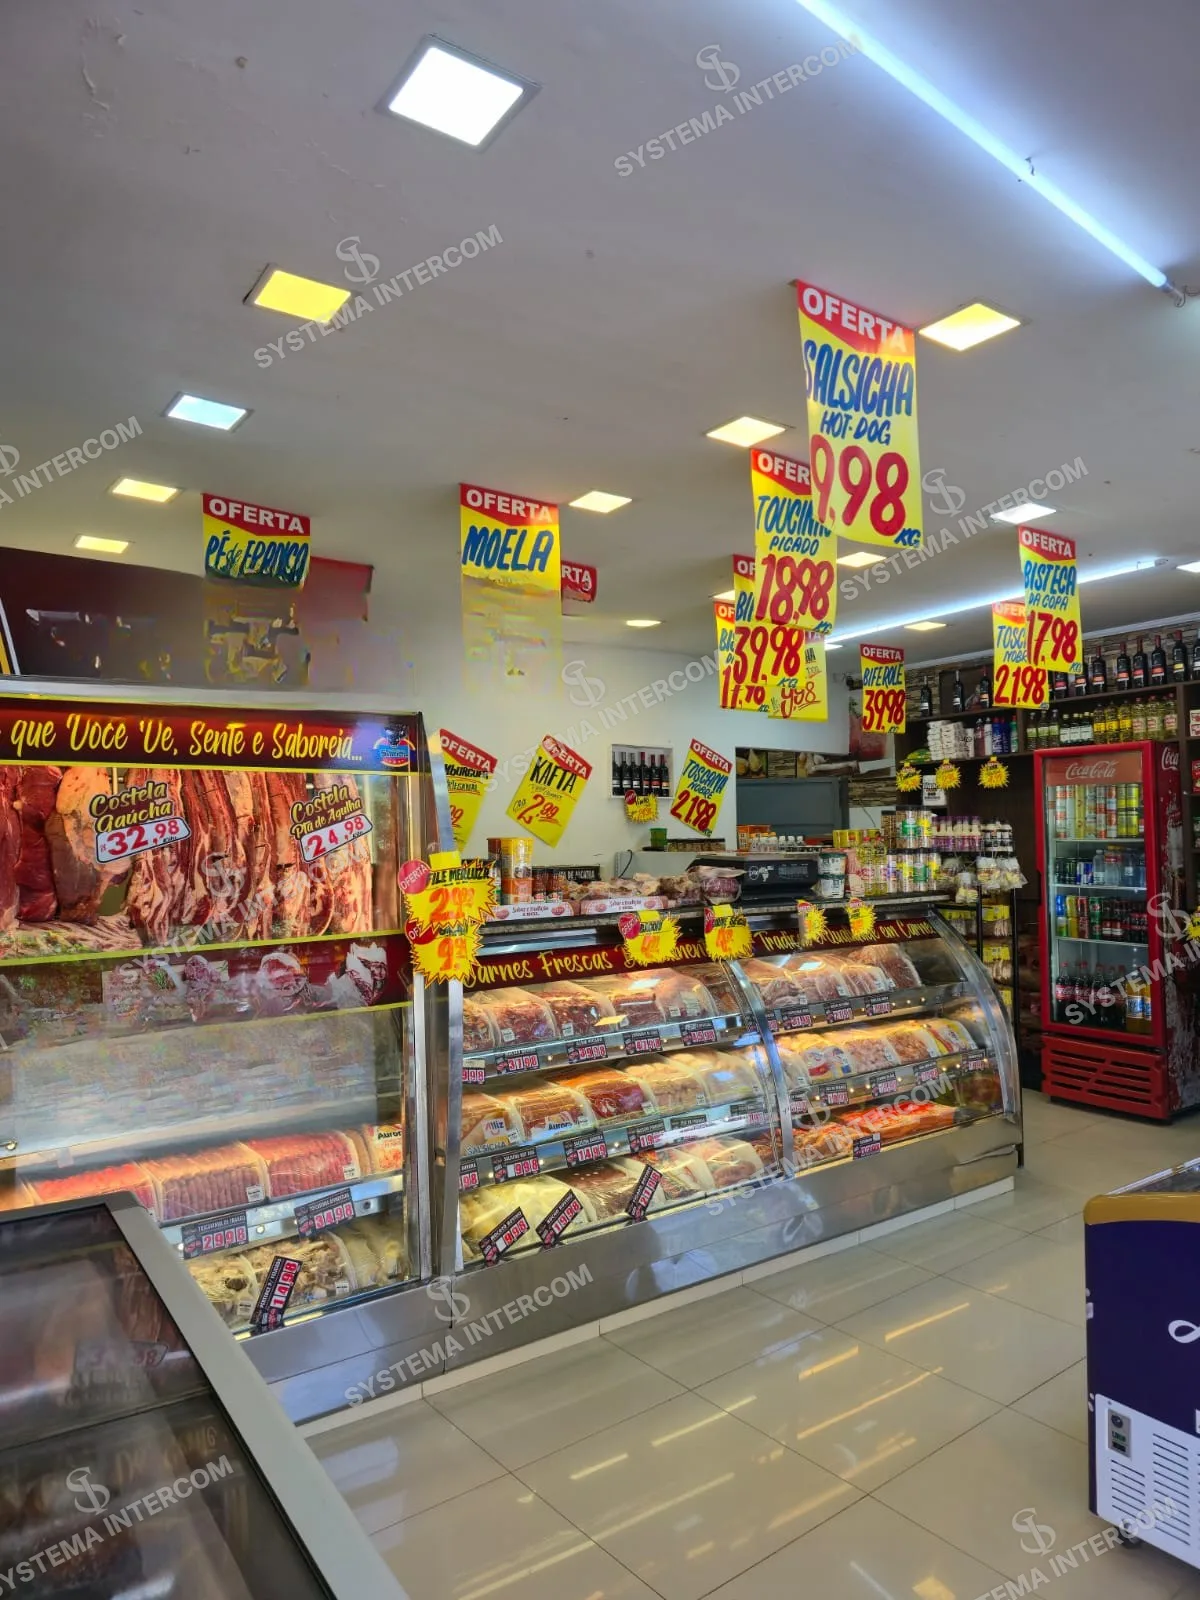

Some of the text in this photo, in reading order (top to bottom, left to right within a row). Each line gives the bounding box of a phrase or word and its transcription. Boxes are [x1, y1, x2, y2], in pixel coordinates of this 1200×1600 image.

[802, 288, 907, 353] OFERTA
[803, 339, 915, 417] SALSICHA
[757, 453, 811, 487] OFER
[208, 498, 305, 534] OFERTA
[466, 489, 553, 523] OFERTA
[461, 525, 555, 573] MOELA
[769, 535, 820, 556] PICADO
[893, 527, 921, 547] KG
[1021, 529, 1073, 558] OFERTA
[1024, 559, 1076, 596] BISTECA
[1028, 594, 1069, 611] DA COPA
[862, 646, 902, 661] OFERTA
[863, 666, 884, 687] BIFE
[11, 718, 56, 758] que
[189, 720, 247, 757] Sente
[252, 734, 265, 755] e
[441, 735, 492, 773] OFERTA
[693, 742, 729, 772] OFERTA
[529, 756, 577, 793] KAFTA
[683, 759, 729, 794] TOSCANA
[687, 782, 715, 800] NOBRE
[90, 780, 168, 816] Costela
[290, 784, 349, 824] Costela
[106, 819, 180, 856] 32,98
[400, 864, 429, 891] OFERTA
[377, 1131, 402, 1141] Auror
